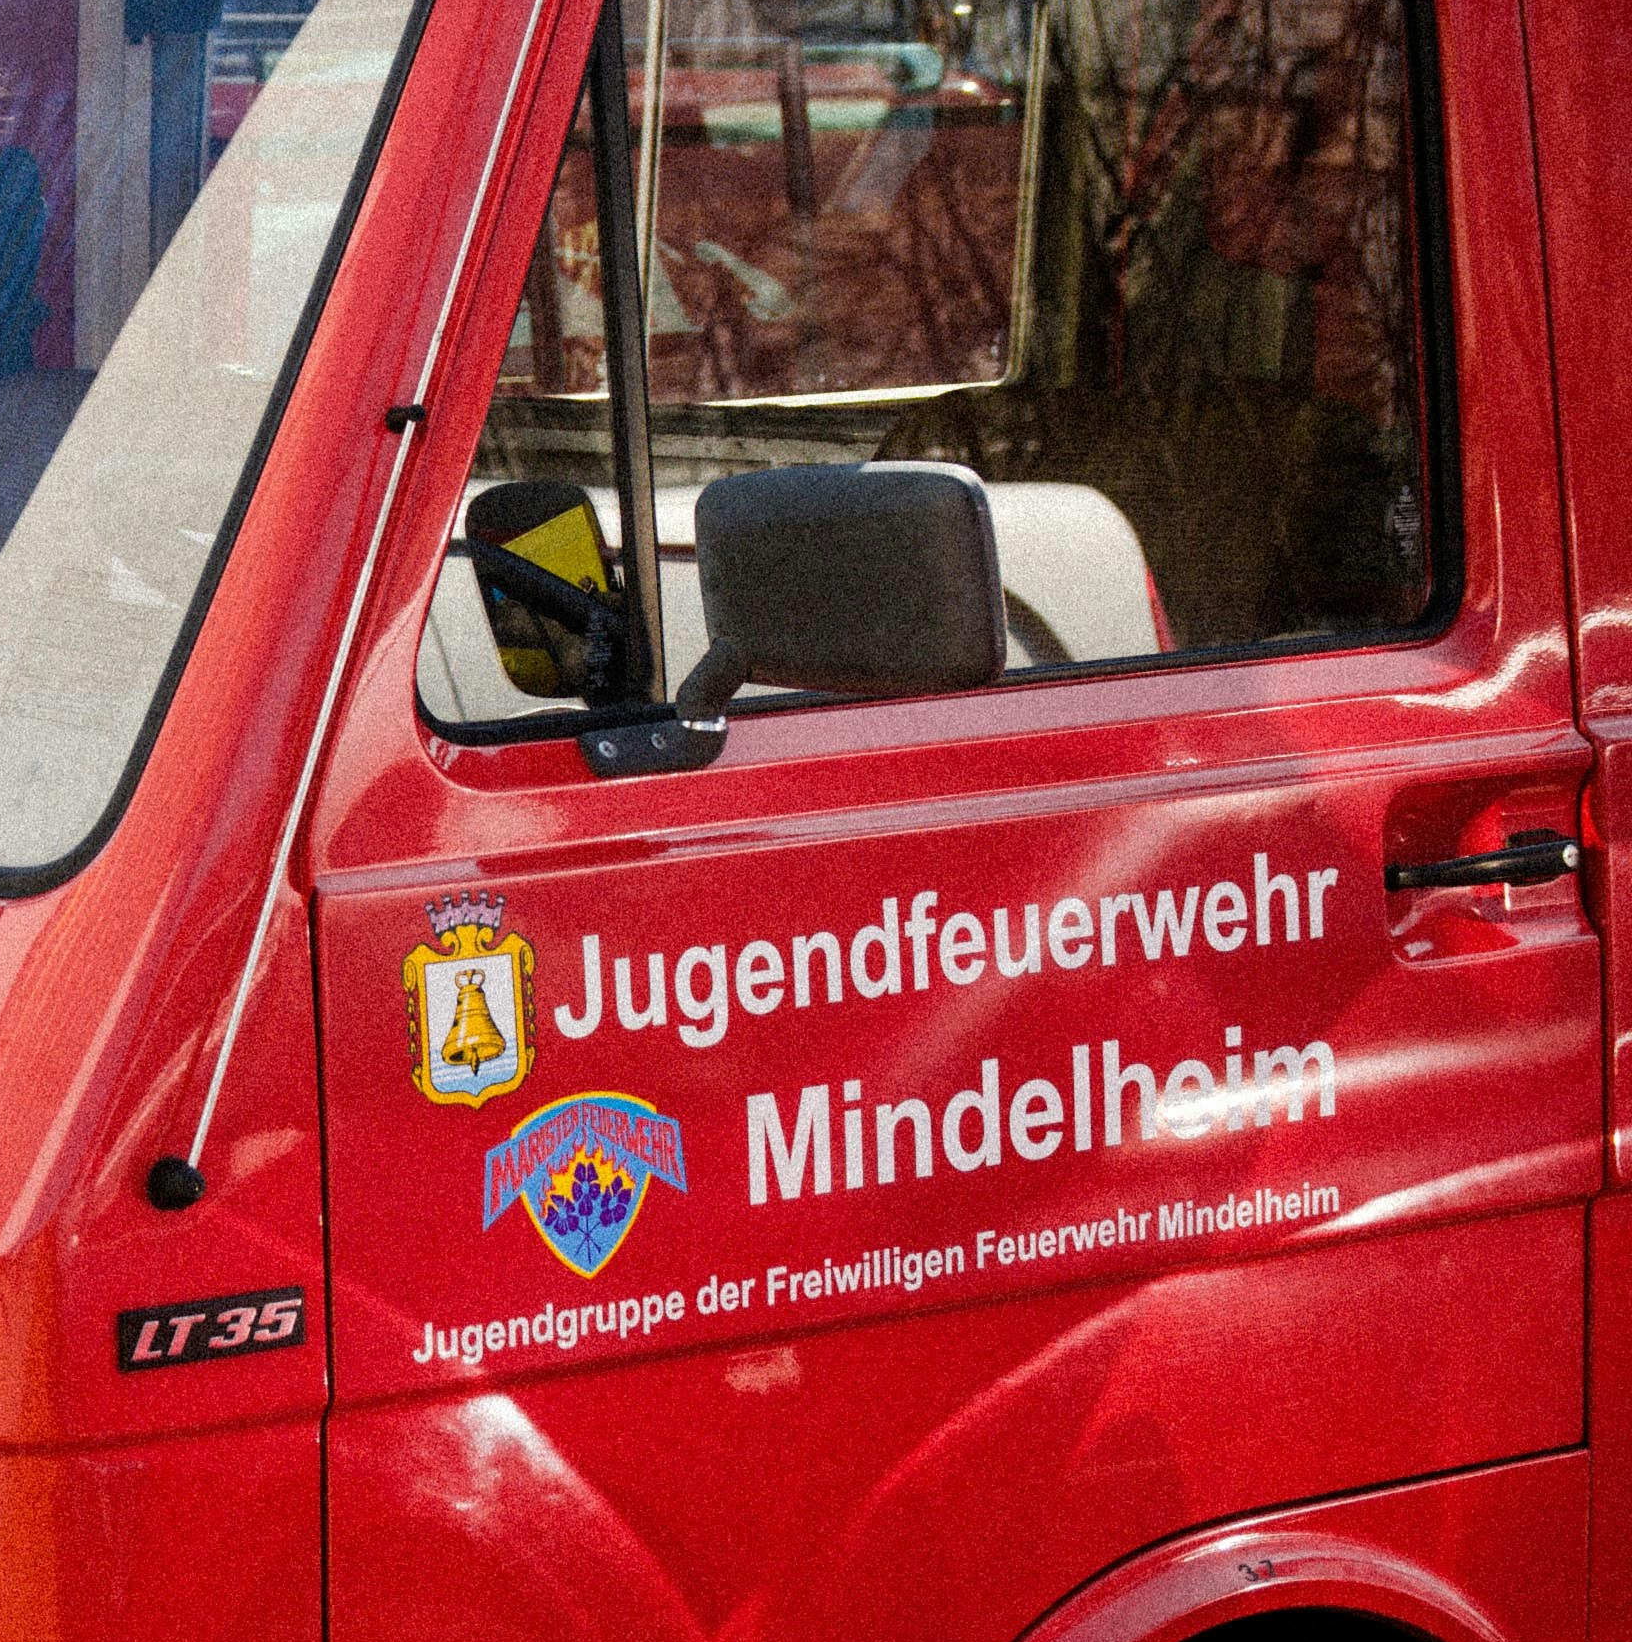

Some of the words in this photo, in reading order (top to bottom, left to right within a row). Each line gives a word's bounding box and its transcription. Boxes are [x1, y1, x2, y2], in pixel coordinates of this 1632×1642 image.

[553, 853, 1338, 1048] Jugendfeuerwehr
[746, 1026, 1336, 1205] Mindelheim
[132, 1314, 205, 1361] LT
[209, 1298, 302, 1348] 35
[412, 1289, 685, 1363] Jugendgruppe
[697, 1274, 755, 1314] der
[768, 1246, 965, 1306] Freiwilligen
[977, 1209, 1152, 1270] Feuerwehr
[1157, 1183, 1339, 1242] Mindelheim
